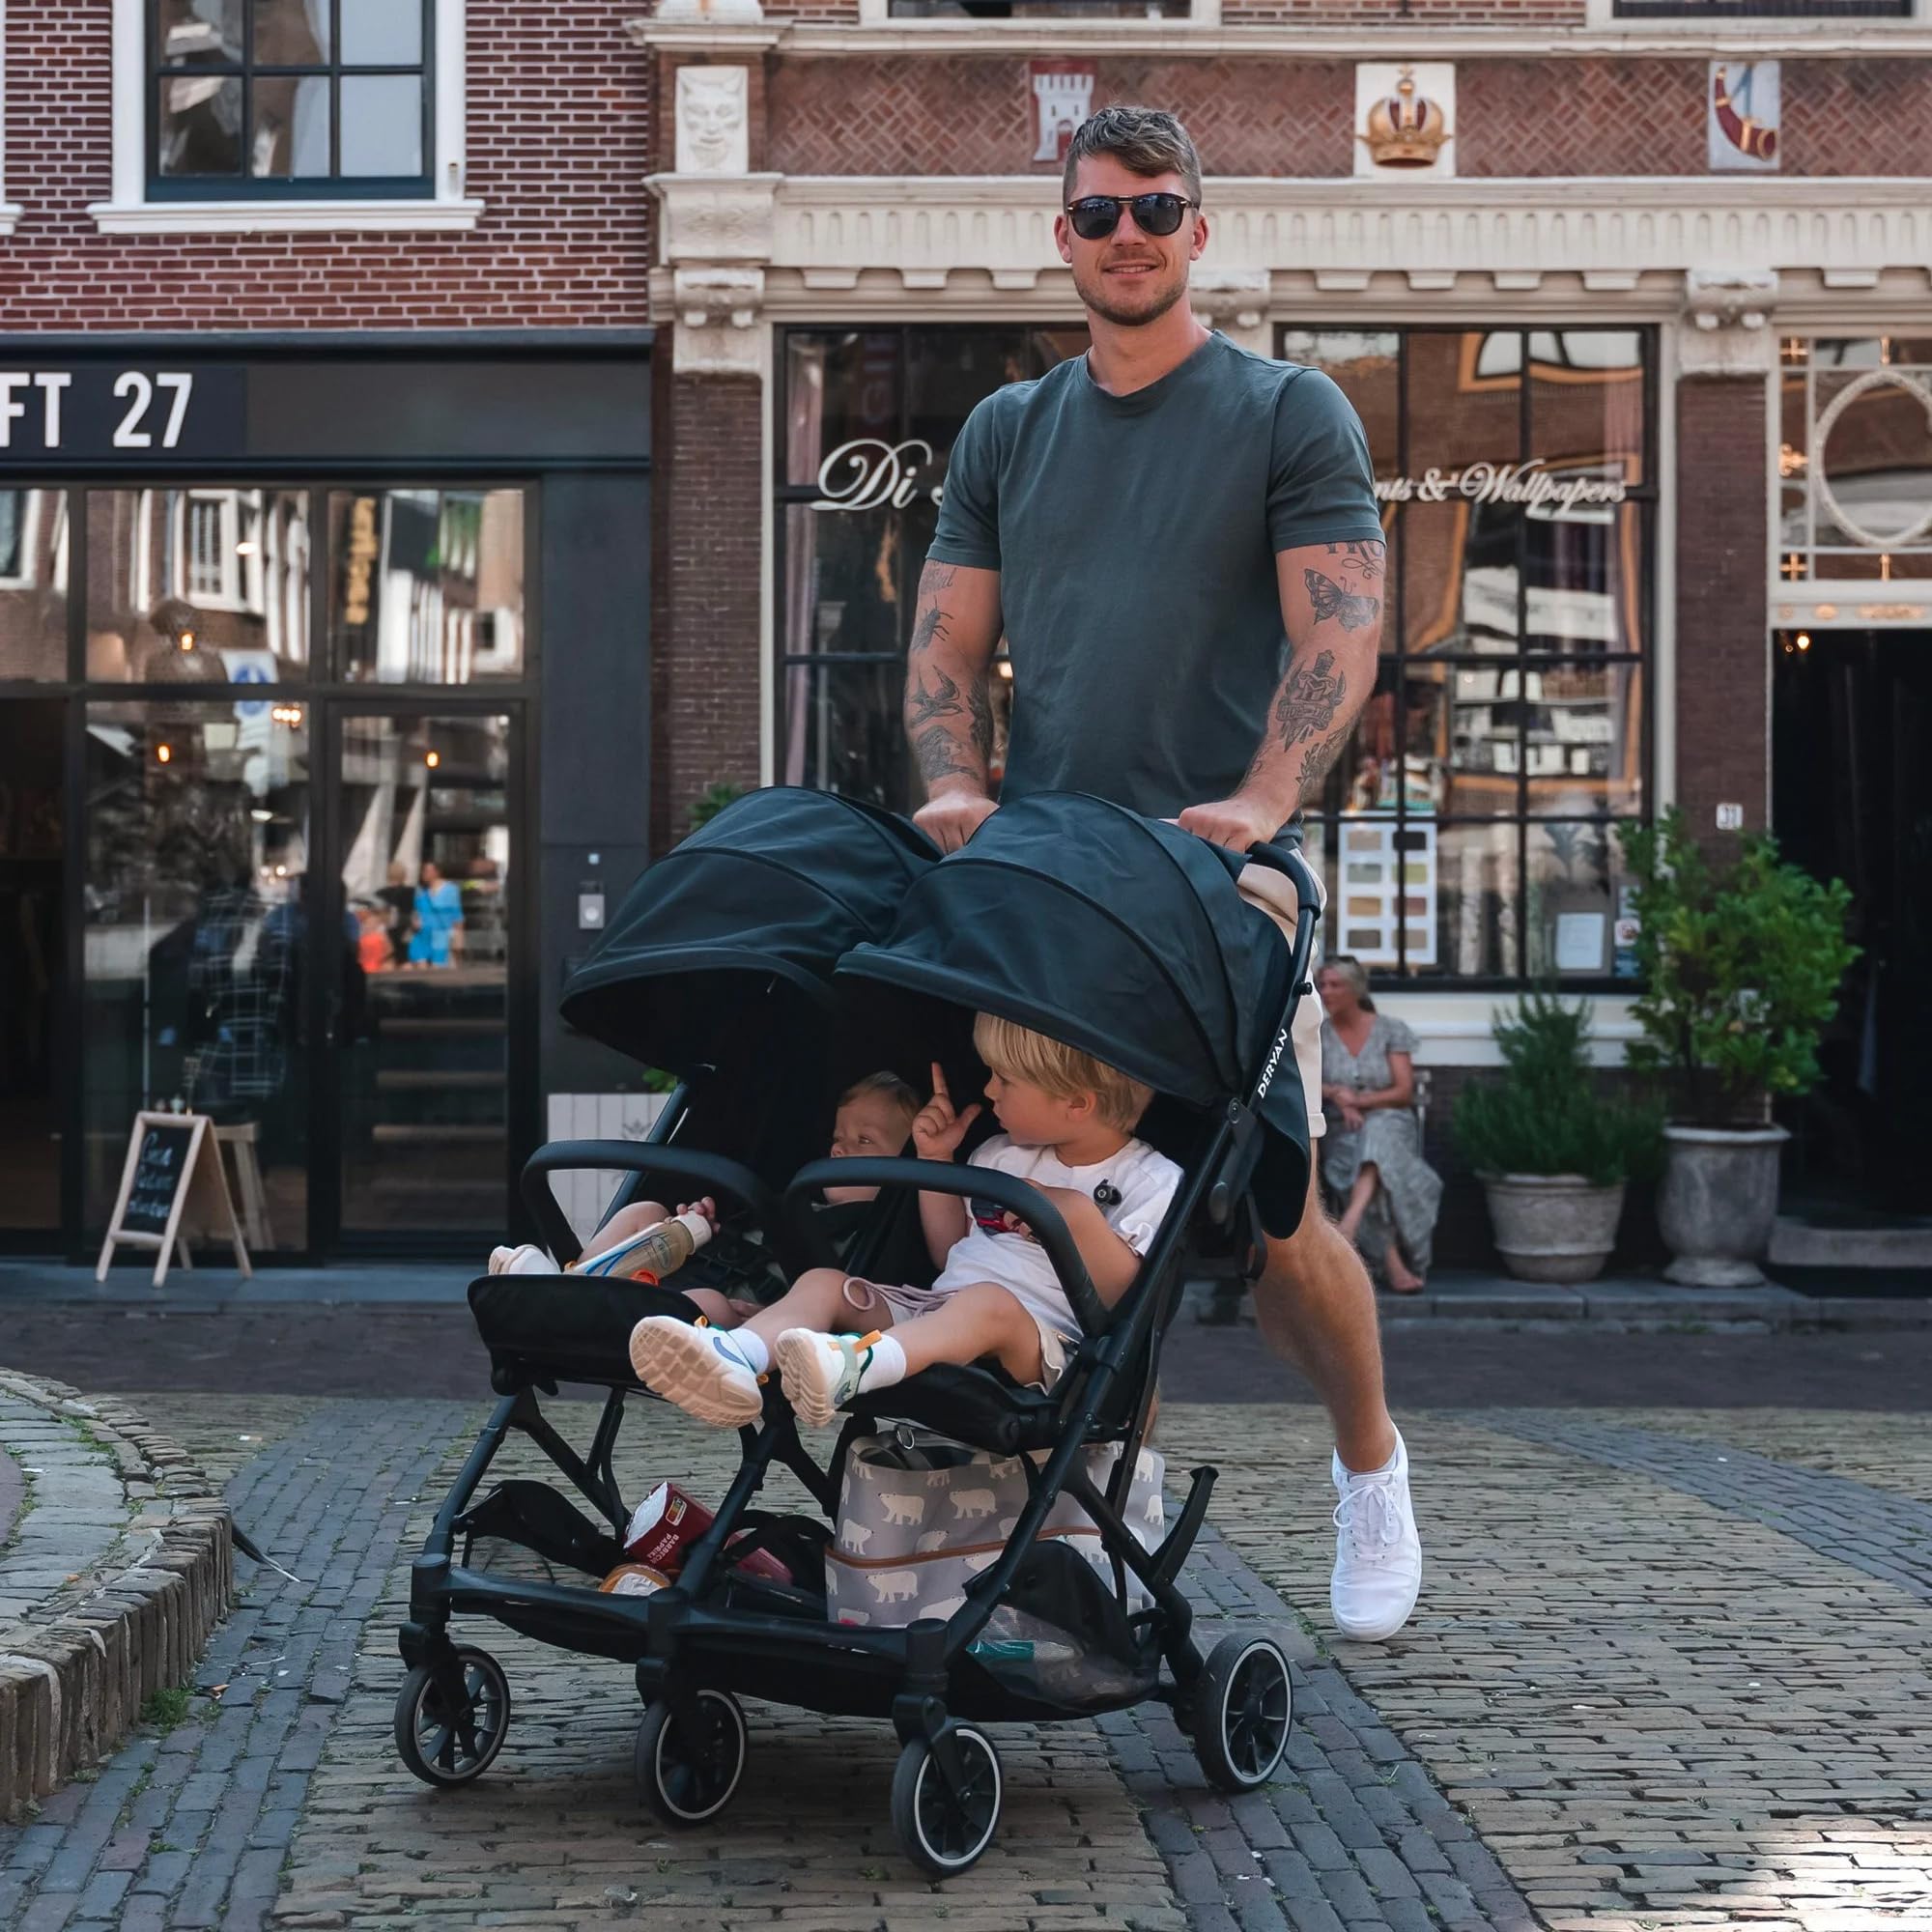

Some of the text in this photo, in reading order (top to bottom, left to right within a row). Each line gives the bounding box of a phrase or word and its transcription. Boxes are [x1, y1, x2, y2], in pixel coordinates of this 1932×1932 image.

[113, 371, 192, 447] 27
[810, 439, 932, 511] Di
[1459, 459, 1627, 518] Wallpapers
[1257, 1028, 1288, 1098] DERYAN
